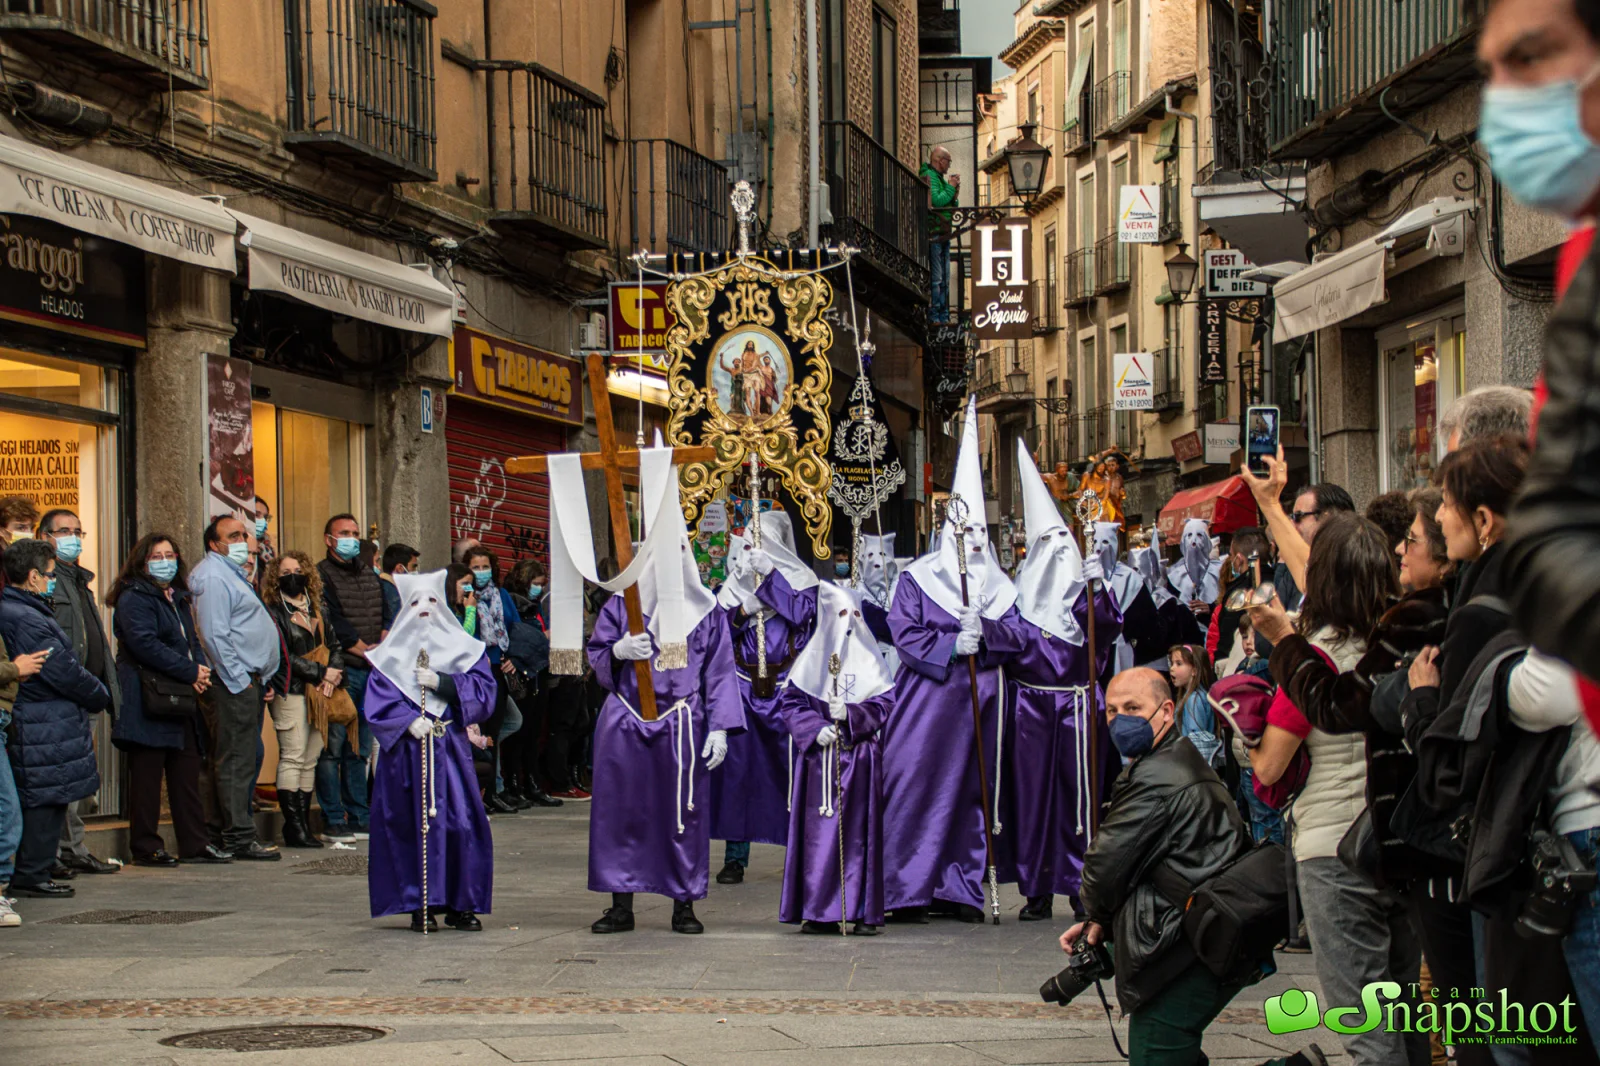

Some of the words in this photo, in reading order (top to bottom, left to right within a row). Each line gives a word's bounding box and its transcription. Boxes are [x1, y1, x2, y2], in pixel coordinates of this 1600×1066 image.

[17, 174, 48, 208] ICE
[51, 185, 112, 223] CREAM
[130, 210, 183, 248] COFFEE
[183, 225, 216, 257] SHOP
[1125, 221, 1153, 230] VENTA
[1120, 232, 1132, 240] 921
[1211, 254, 1236, 266] GEST
[281, 262, 347, 301] PASTELERIA
[359, 285, 395, 317] BAKERY
[399, 297, 425, 324] FOOD
[1232, 281, 1255, 291] DIEZ
[41, 295, 84, 320] HELADOS
[974, 301, 1029, 332] Segovia
[494, 347, 572, 405] TABACOS
[1120, 389, 1147, 398] VENTA
[1116, 400, 1127, 408] 921
[1128, 399, 1153, 408] 412090
[0, 440, 17, 455] GGI
[19, 439, 61, 455] HELADOS
